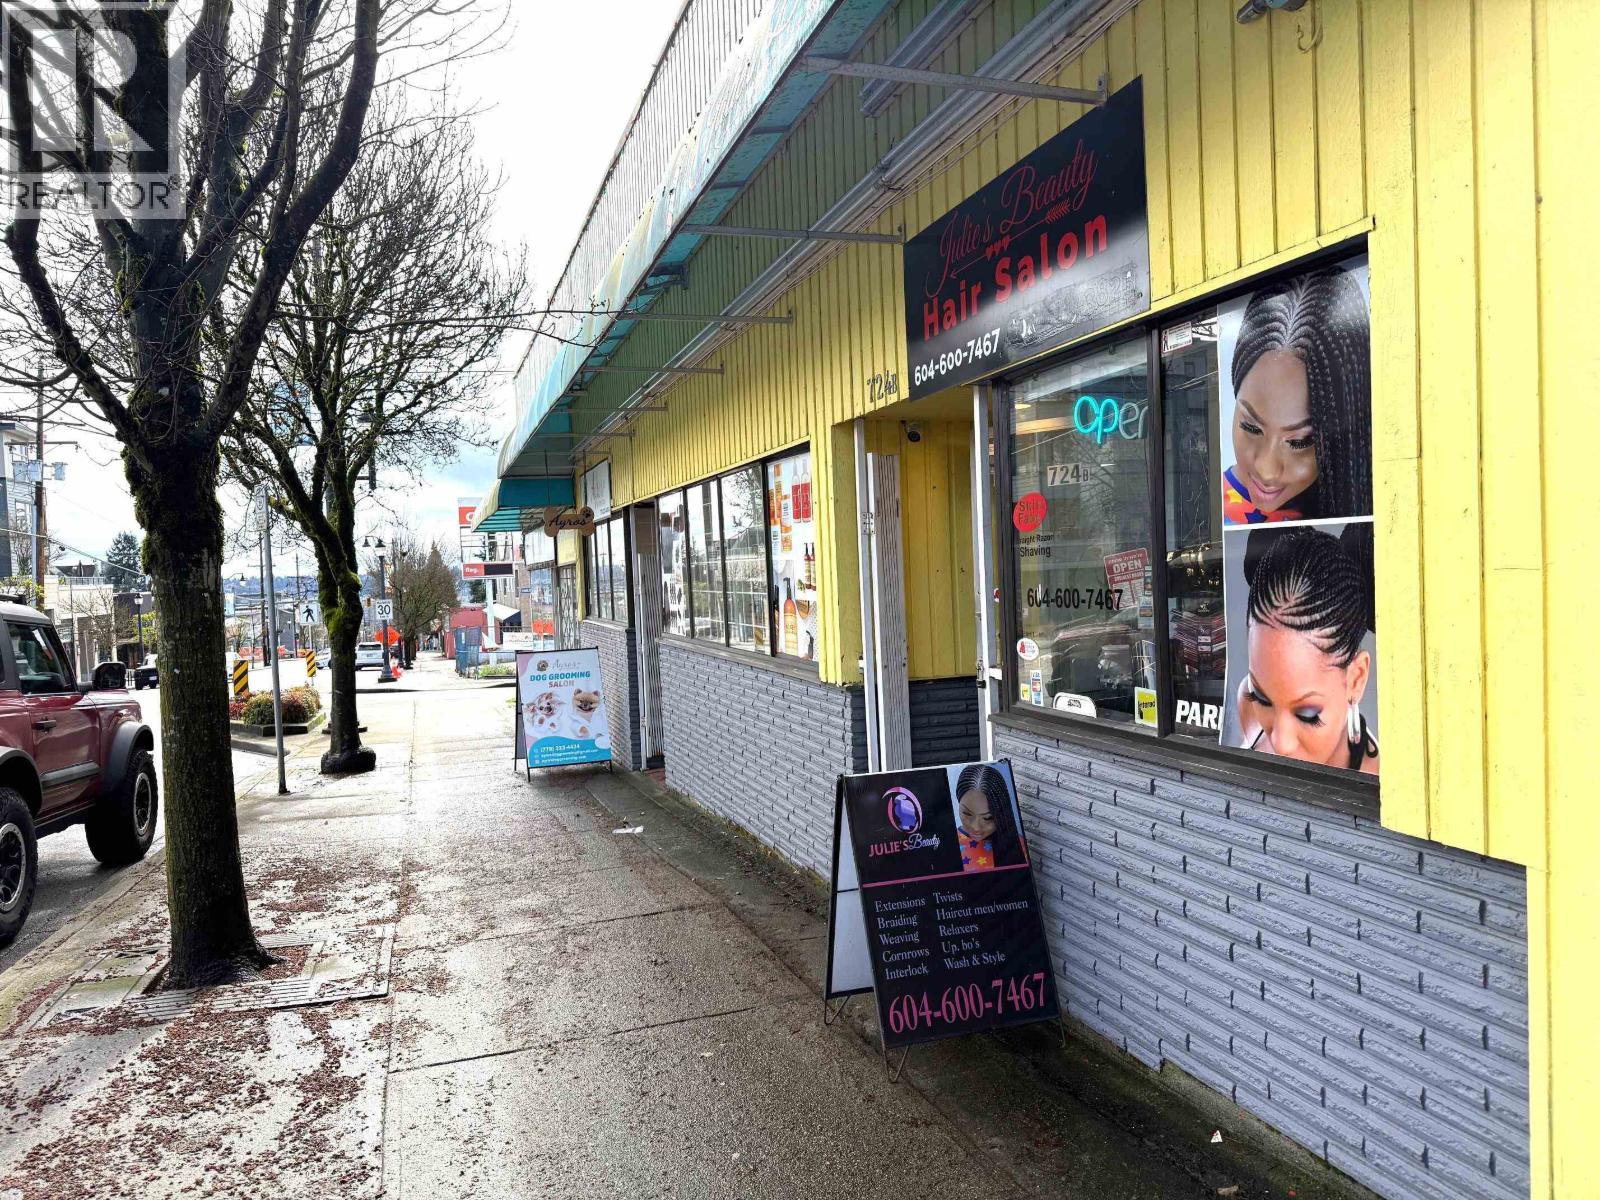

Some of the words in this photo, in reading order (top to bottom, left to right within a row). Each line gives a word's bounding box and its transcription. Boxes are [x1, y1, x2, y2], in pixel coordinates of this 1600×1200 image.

[1000, 138, 1098, 233] Beauty
[923, 279, 983, 342] Hair
[995, 214, 1107, 303] Salon
[914, 327, 1001, 386] 604-600-7467
[867, 370, 898, 403] 724B
[1019, 545, 1051, 558] Shaving
[1113, 559, 1142, 574] OPEN
[1027, 588, 1123, 611] 604-600-7467
[377, 604, 391, 615] 30
[530, 674, 547, 682] DOG
[548, 671, 591, 681] GROOMING
[548, 680, 575, 688] SALON
[868, 839, 909, 857] JULIE'S
[908, 832, 941, 851] Beauty
[874, 897, 926, 913] Extensions
[933, 891, 963, 904] Twists
[935, 907, 973, 921] Haircut
[974, 900, 1029, 914] men/women
[877, 913, 918, 929] Braiding
[879, 930, 920, 946] Weaving
[938, 923, 979, 937] Relaxers
[882, 948, 930, 963] Cornrows
[943, 956, 970, 970] Wash
[972, 954, 981, 966] &
[981, 950, 1006, 965] Style
[885, 962, 929, 980] Interlock
[888, 972, 1046, 1034] 604-600-7467
